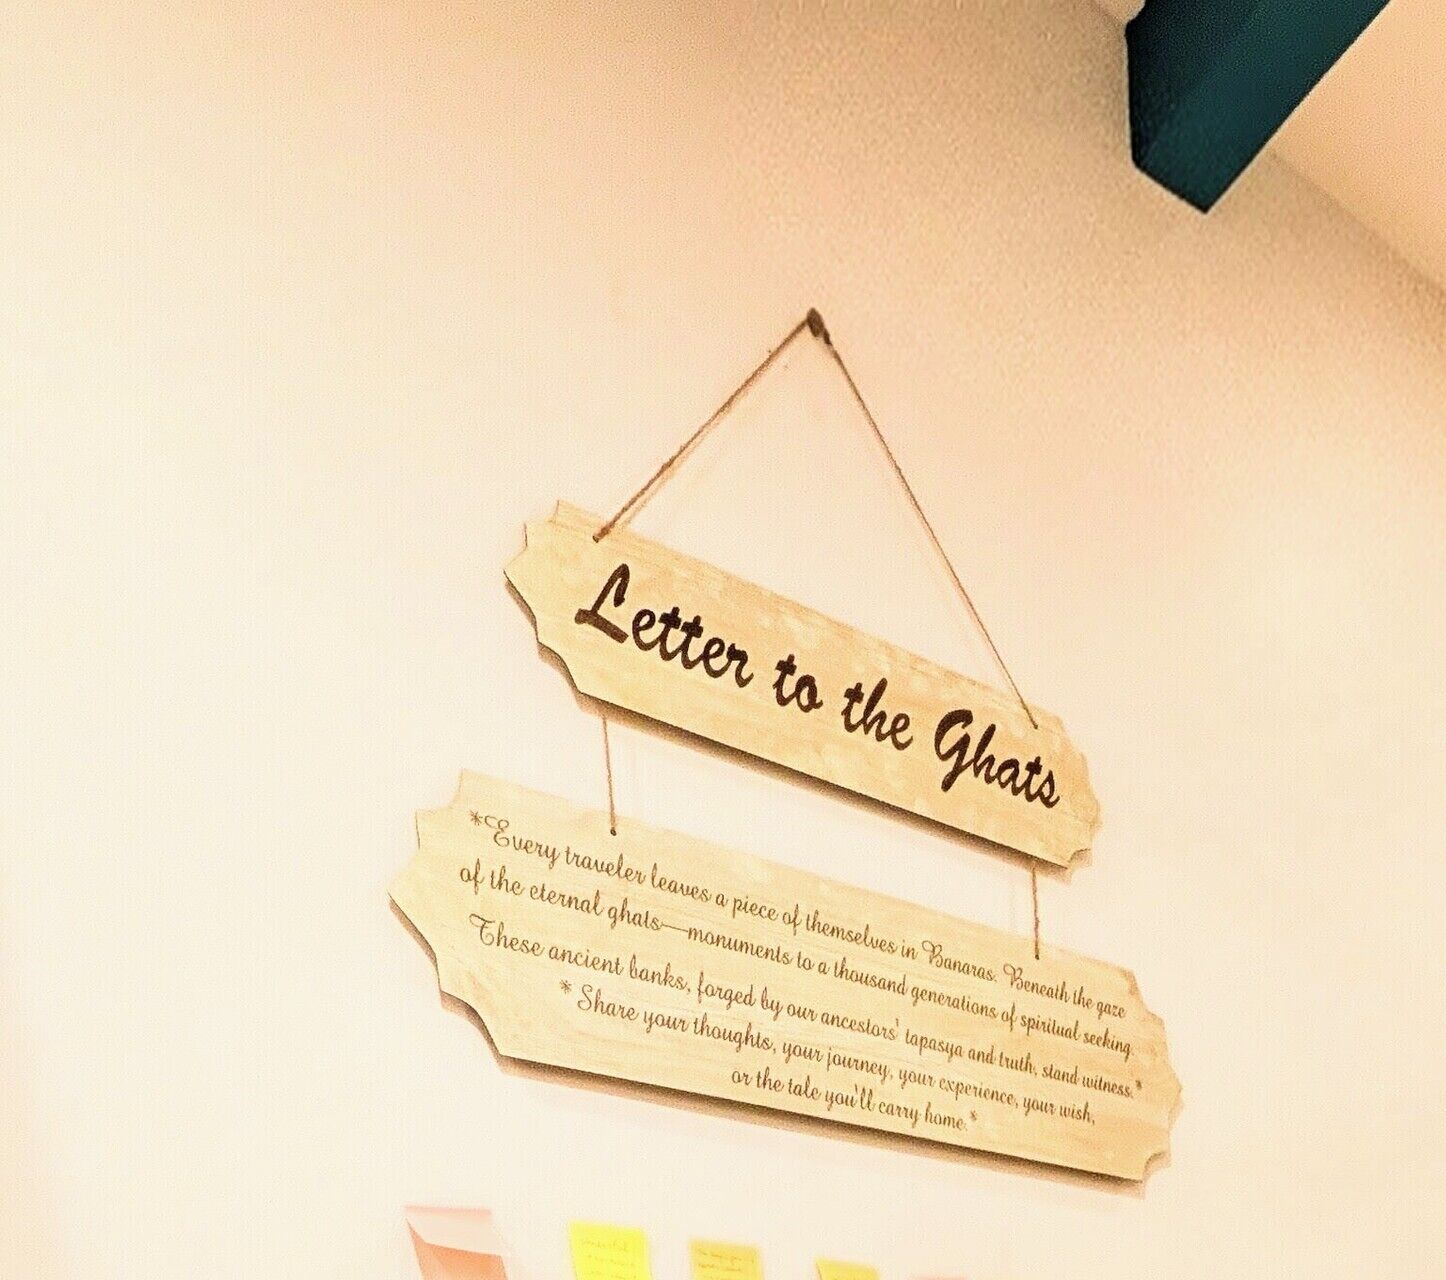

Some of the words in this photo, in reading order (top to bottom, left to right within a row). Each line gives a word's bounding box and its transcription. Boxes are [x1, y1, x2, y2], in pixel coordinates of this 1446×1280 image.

[574, 563, 754, 689] Letter
[773, 653, 824, 714] to
[841, 677, 914, 752] the
[933, 708, 1061, 810] Ghats
[460, 857, 484, 895] of
[490, 865, 525, 896] the
[529, 889, 605, 916] eternal
[796, 951, 815, 971] to
[818, 960, 830, 975] a
[833, 957, 907, 996] thousand
[911, 985, 999, 1020] generations
[1001, 999, 1018, 1033] of
[1020, 1012, 1081, 1042] spiritual
[1083, 1026, 1135, 1062] seeking.
[469, 913, 545, 957] These
[548, 943, 624, 976] ancient
[629, 953, 691, 993] banks,
[696, 971, 757, 1011] forged
[760, 986, 784, 1017] by
[786, 1001, 818, 1022] our
[905, 1028, 964, 1061] tapasya
[968, 1044, 996, 1067] and
[999, 1049, 1038, 1077] truth,
[1041, 1060, 1080, 1086] stand
[564, 852, 647, 885] traveler
[650, 863, 713, 902] leaves
[716, 892, 729, 907] a
[731, 895, 778, 924] piece
[782, 903, 802, 936] of
[806, 908, 898, 955] themselves
[901, 939, 918, 960] in
[921, 940, 998, 983] Banaras.
[1003, 962, 1071, 1003] Beneath
[1073, 987, 1094, 1010] the
[1096, 998, 1127, 1020] gaze
[577, 984, 640, 1021] Share
[643, 1009, 690, 1033] your
[693, 1016, 777, 1054] thoughts,
[782, 1041, 824, 1065] your
[826, 1047, 894, 1082] journey,
[898, 1066, 937, 1092] your
[939, 1075, 1018, 1109] experience,
[1023, 1094, 1056, 1118] your
[1059, 1103, 1096, 1125] wish,
[731, 1068, 753, 1086] or
[756, 1067, 784, 1092] the
[788, 1078, 822, 1102] tale
[878, 1100, 921, 1130] carry
